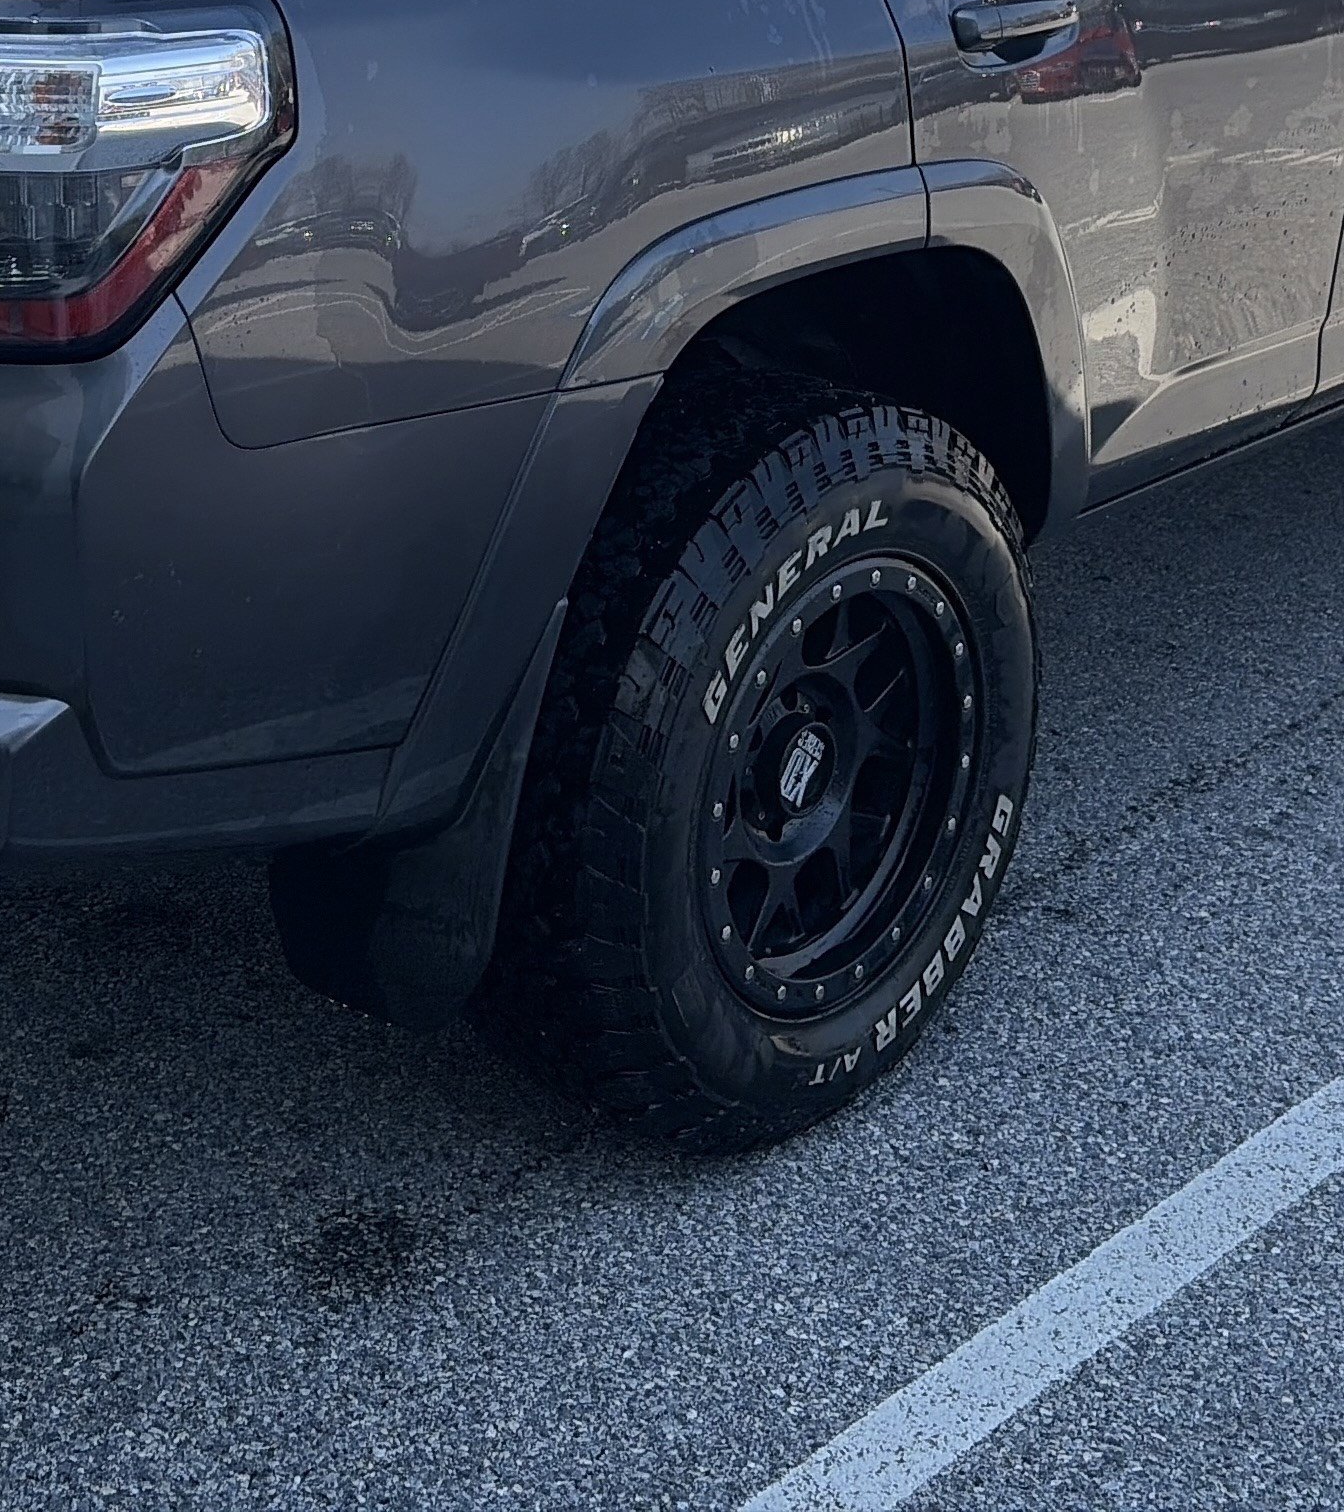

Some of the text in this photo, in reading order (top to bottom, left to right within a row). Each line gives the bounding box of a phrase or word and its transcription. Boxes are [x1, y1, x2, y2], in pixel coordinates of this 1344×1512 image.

[702, 500, 888, 724] GENERAL
[780, 747, 819, 807] XD
[808, 794, 1014, 1086] GRABBER A/T
